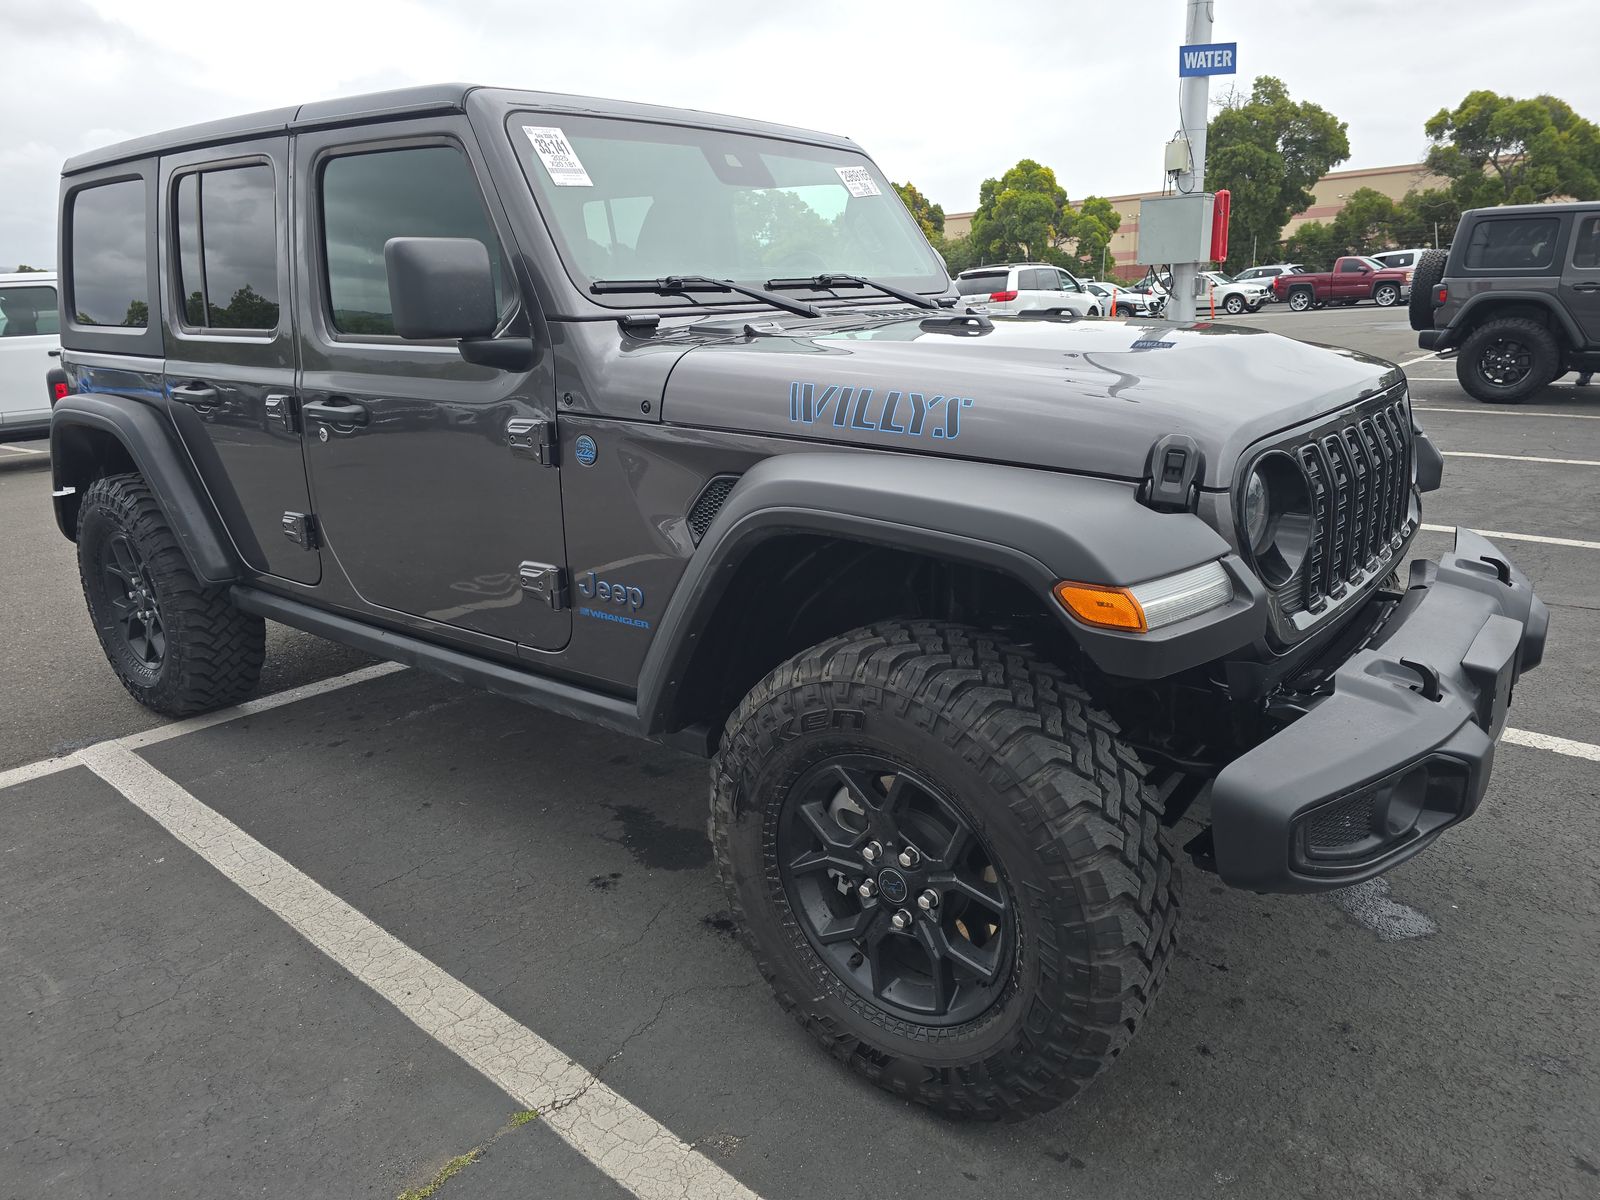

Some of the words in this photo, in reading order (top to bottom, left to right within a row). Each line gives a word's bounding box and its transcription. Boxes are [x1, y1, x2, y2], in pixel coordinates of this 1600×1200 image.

[1183, 50, 1232, 69] WATER
[534, 138, 570, 155] 33:141
[789, 381, 974, 439] WILLYS
[578, 571, 645, 613] Jeep
[589, 609, 650, 629] WRANGLER
